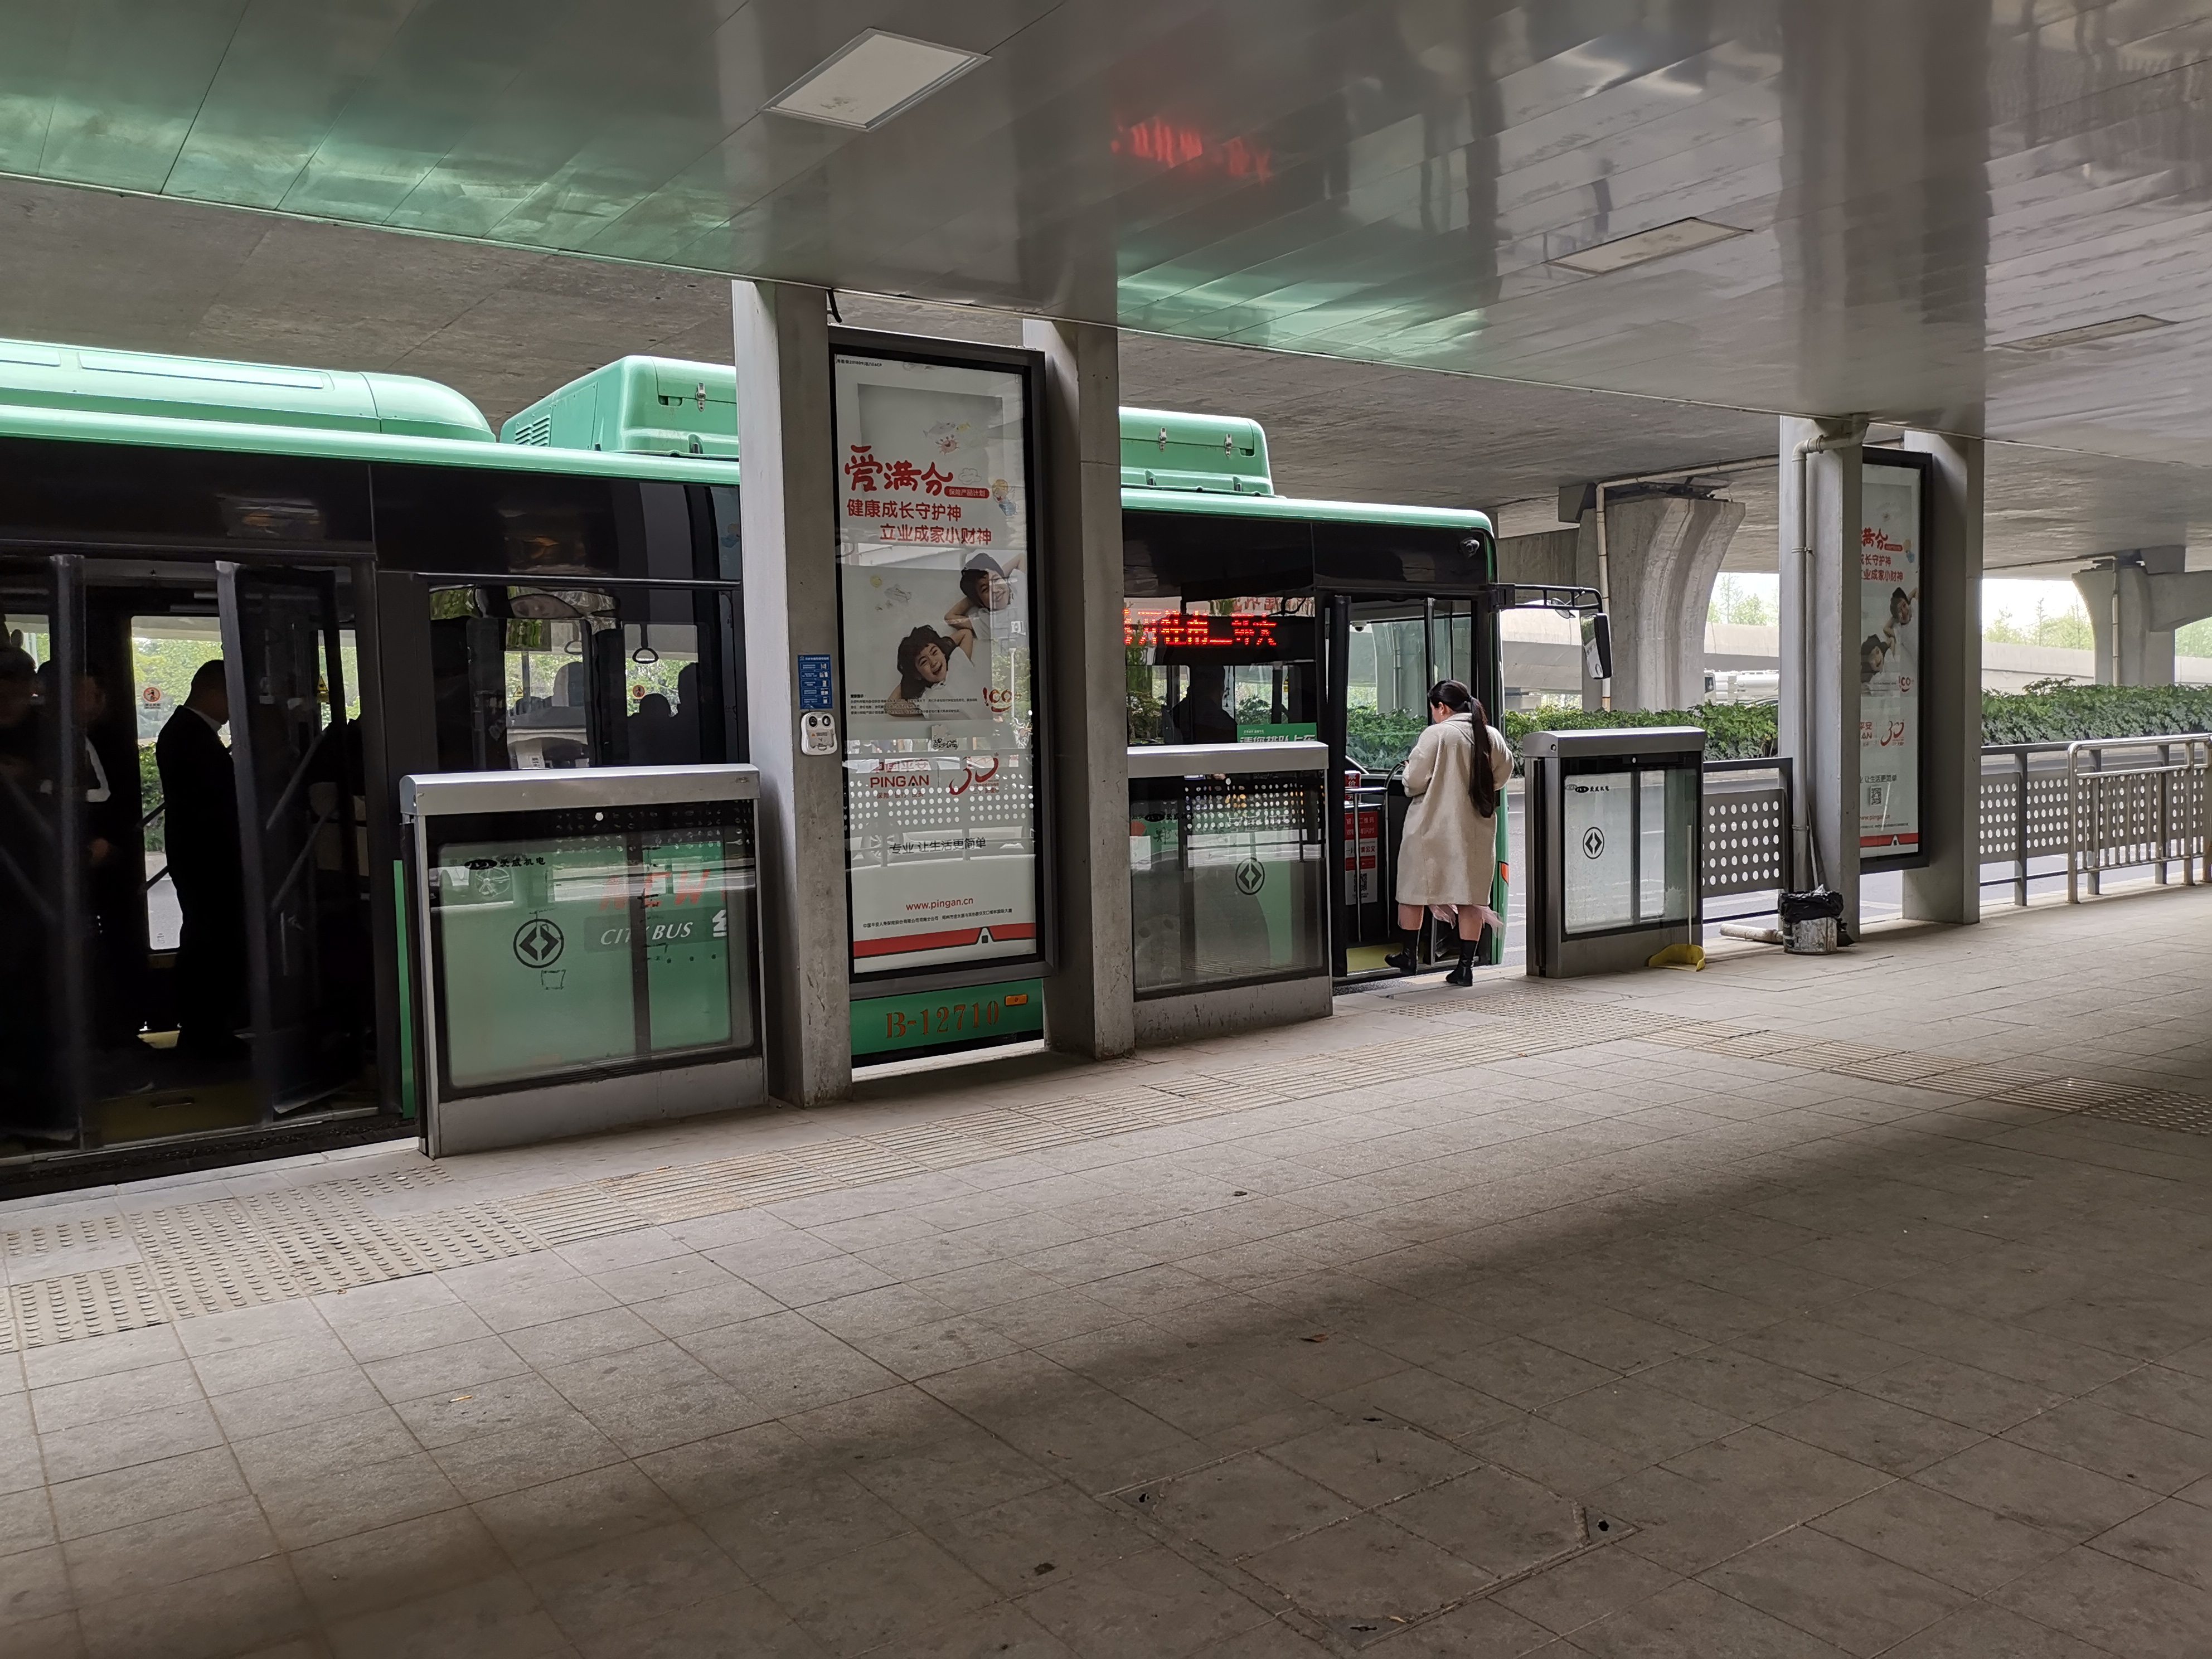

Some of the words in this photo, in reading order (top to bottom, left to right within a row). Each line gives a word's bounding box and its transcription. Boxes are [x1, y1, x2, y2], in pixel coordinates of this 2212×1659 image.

[845, 445, 953, 496] 爱满分
[949, 488, 986, 497] 保险产品计划
[847, 499, 961, 522] 健康成长守护神
[880, 524, 992, 545] 立业成家小财神
[1861, 569, 1903, 581] 业成家小财神
[870, 759, 929, 773] 中国平安
[870, 775, 929, 788] PINGAN
[890, 842, 914, 855] 专业
[918, 837, 986, 852] 让生活更简单
[499, 856, 546, 867] 爱威机电
[906, 898, 973, 911] www.pingan.cn
[600, 926, 649, 945] CIT
[652, 921, 693, 940] BUS
[885, 1000, 999, 1039] B-12710
